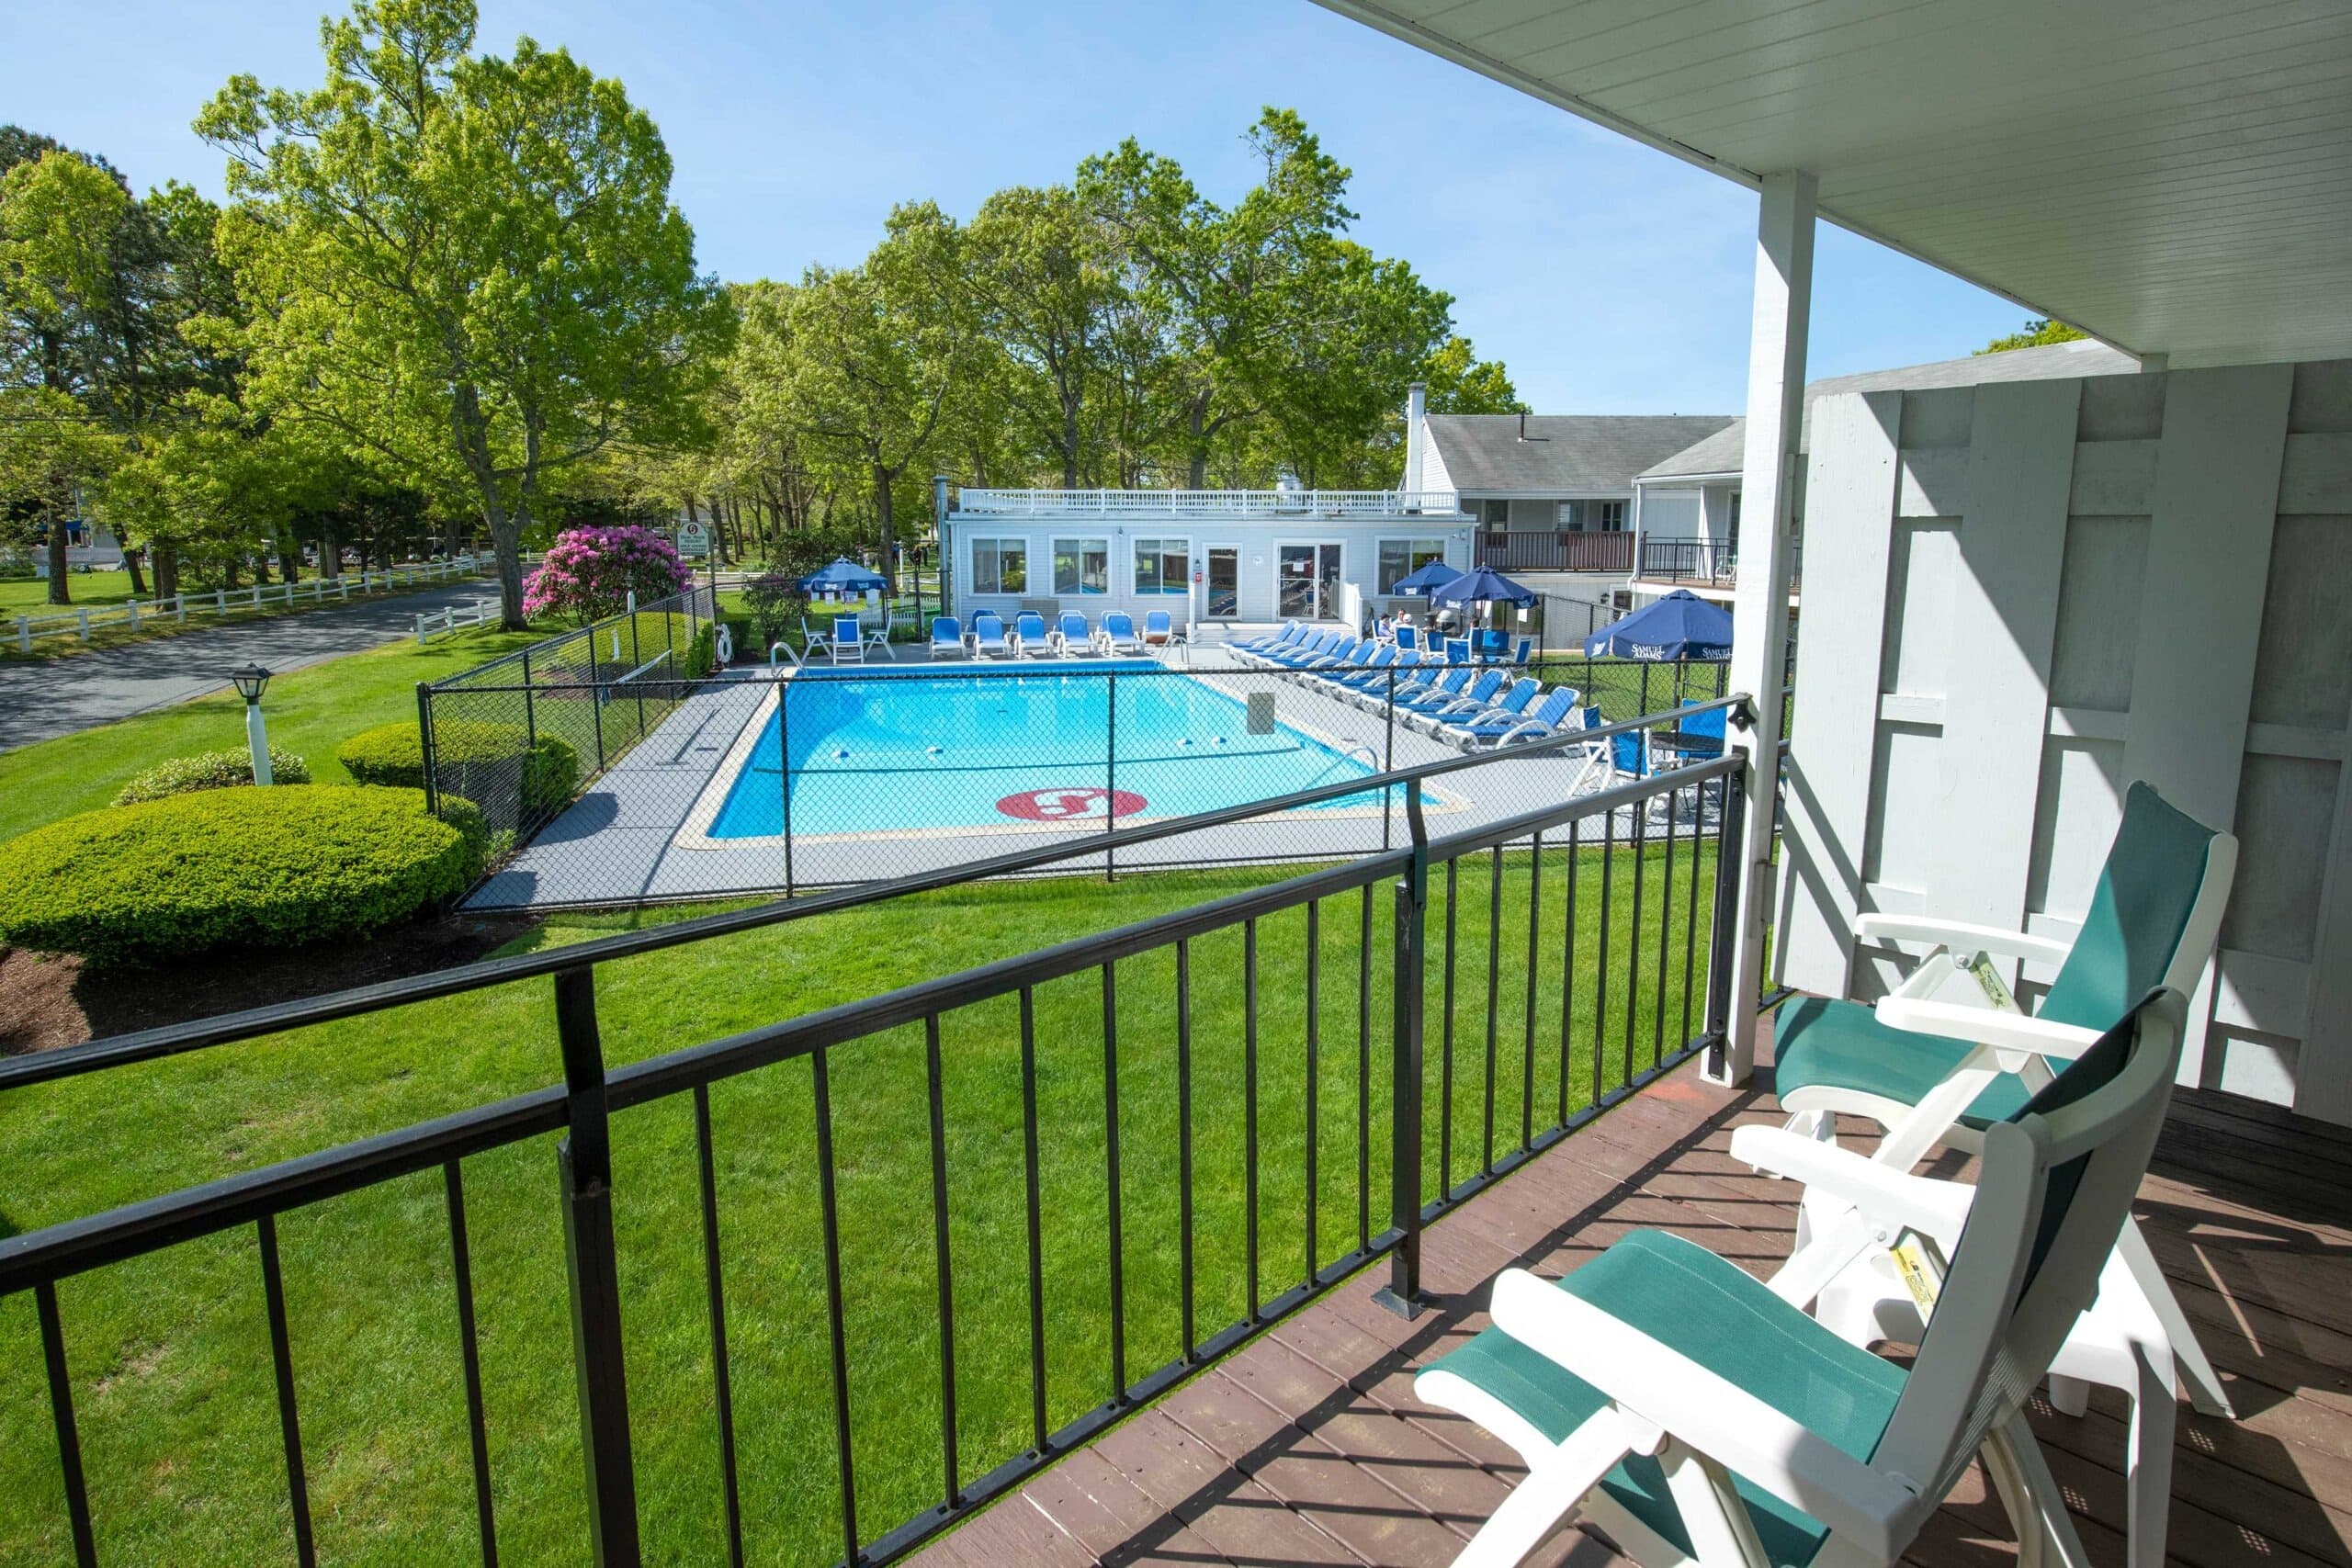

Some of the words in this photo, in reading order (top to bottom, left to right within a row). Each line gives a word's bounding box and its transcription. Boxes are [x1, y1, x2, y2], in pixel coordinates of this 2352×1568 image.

[1632, 644, 1664, 653] SAMUEL
[1702, 648, 1733, 657] SAMUEL
[1633, 651, 1662, 660] ADAMS
